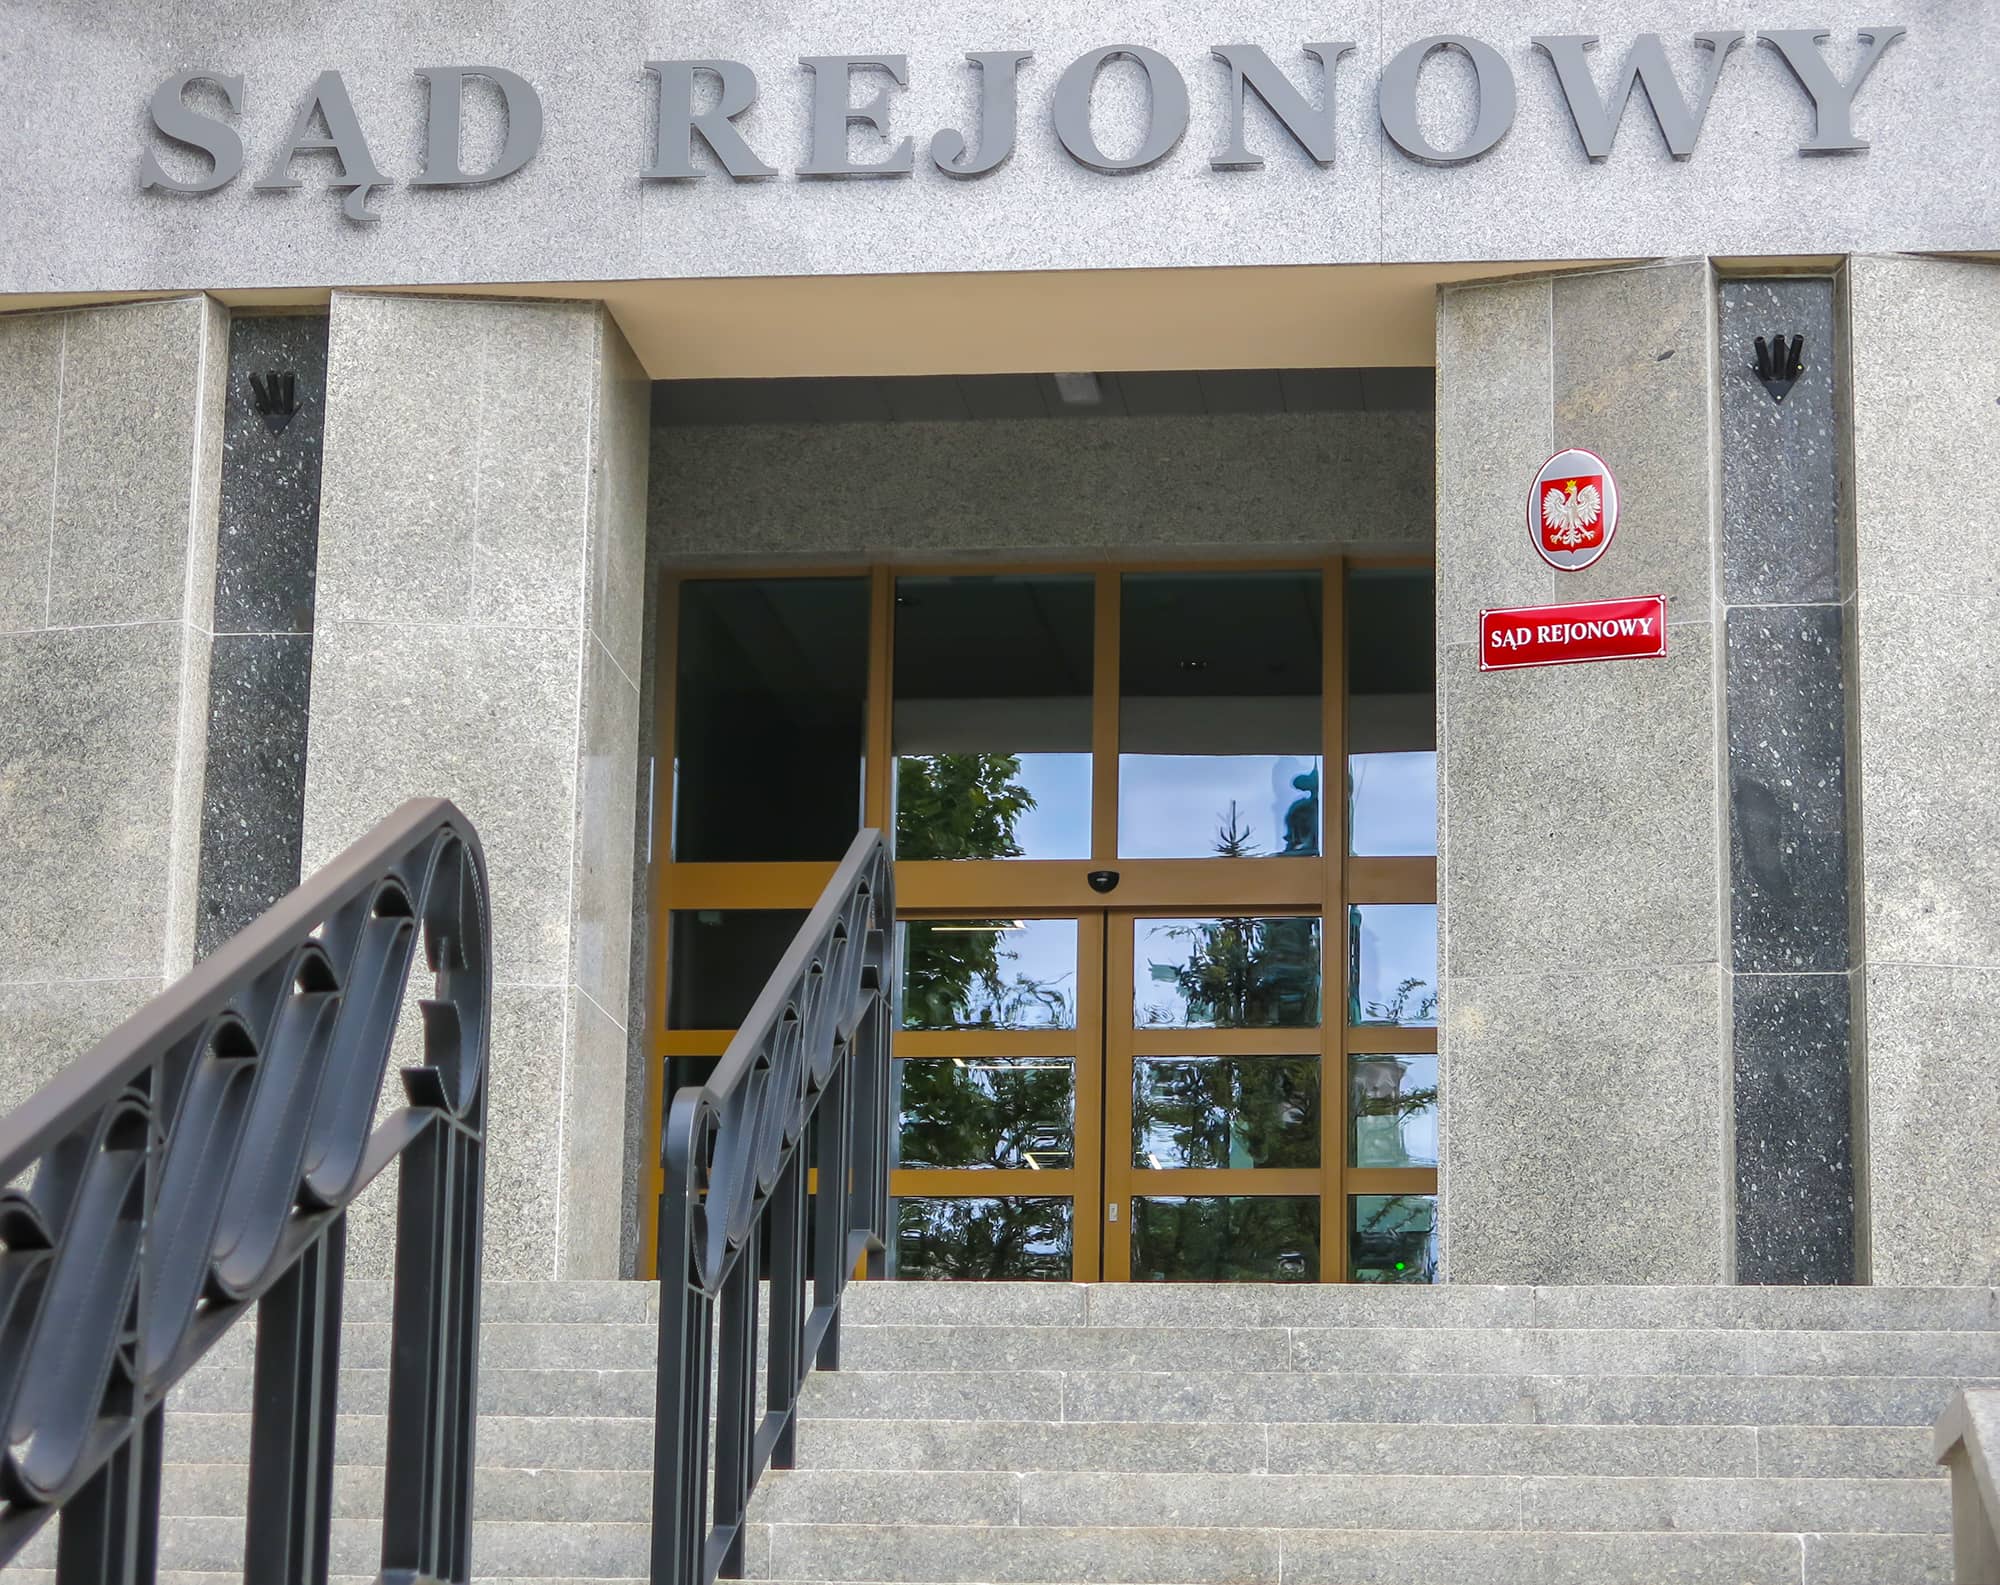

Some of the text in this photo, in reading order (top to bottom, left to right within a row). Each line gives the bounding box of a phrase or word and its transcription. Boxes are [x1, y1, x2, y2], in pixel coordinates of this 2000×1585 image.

[139, 26, 1907, 222] SĄD REJONOWY
[1491, 617, 1654, 650] SĄD REJONOWY
